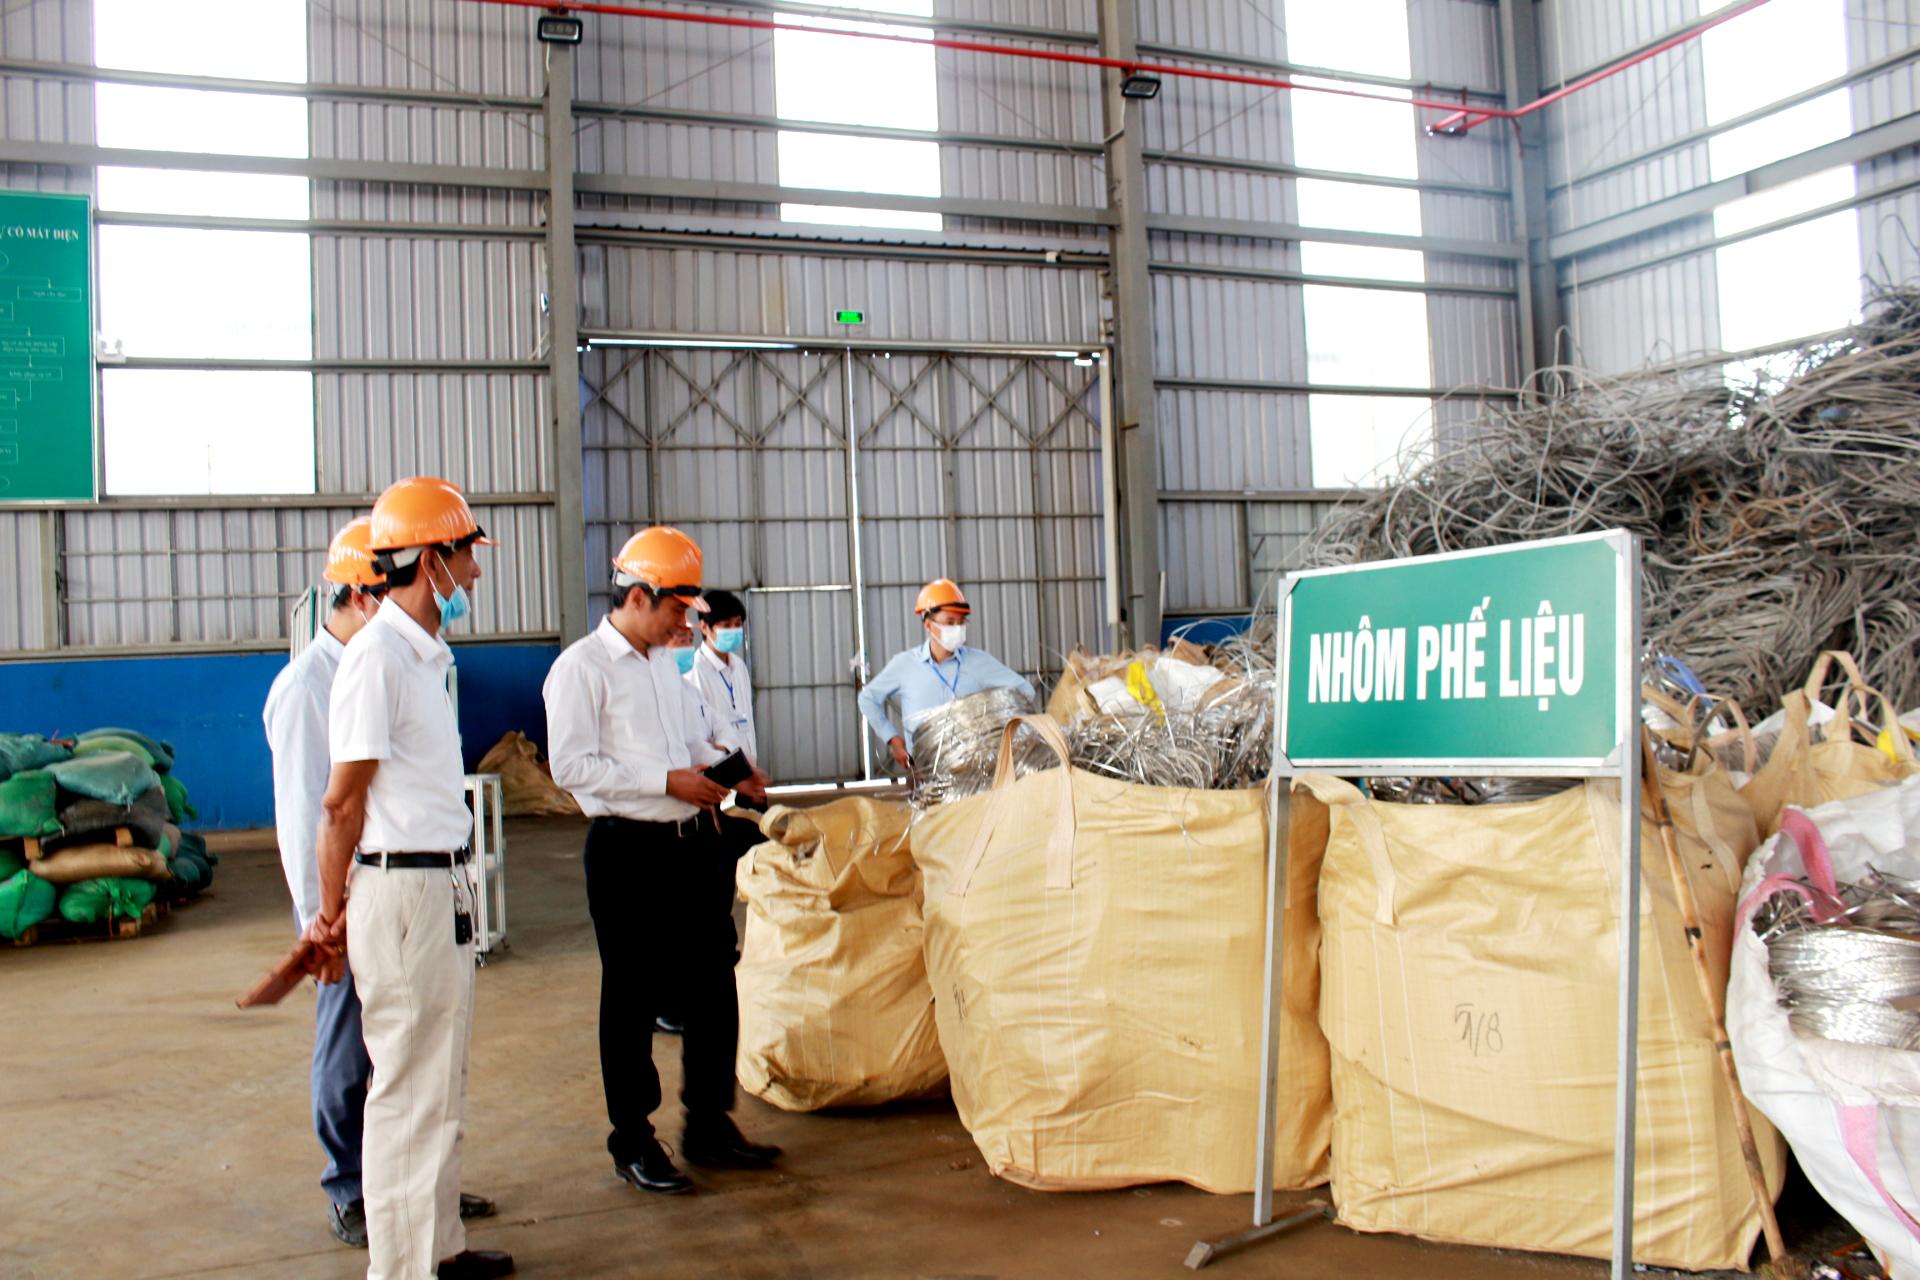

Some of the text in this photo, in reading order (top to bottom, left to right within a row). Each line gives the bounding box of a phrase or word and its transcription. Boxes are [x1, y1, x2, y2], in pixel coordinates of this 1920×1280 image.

[1308, 596, 1584, 711] NHÔM PHẾ LIỆU
